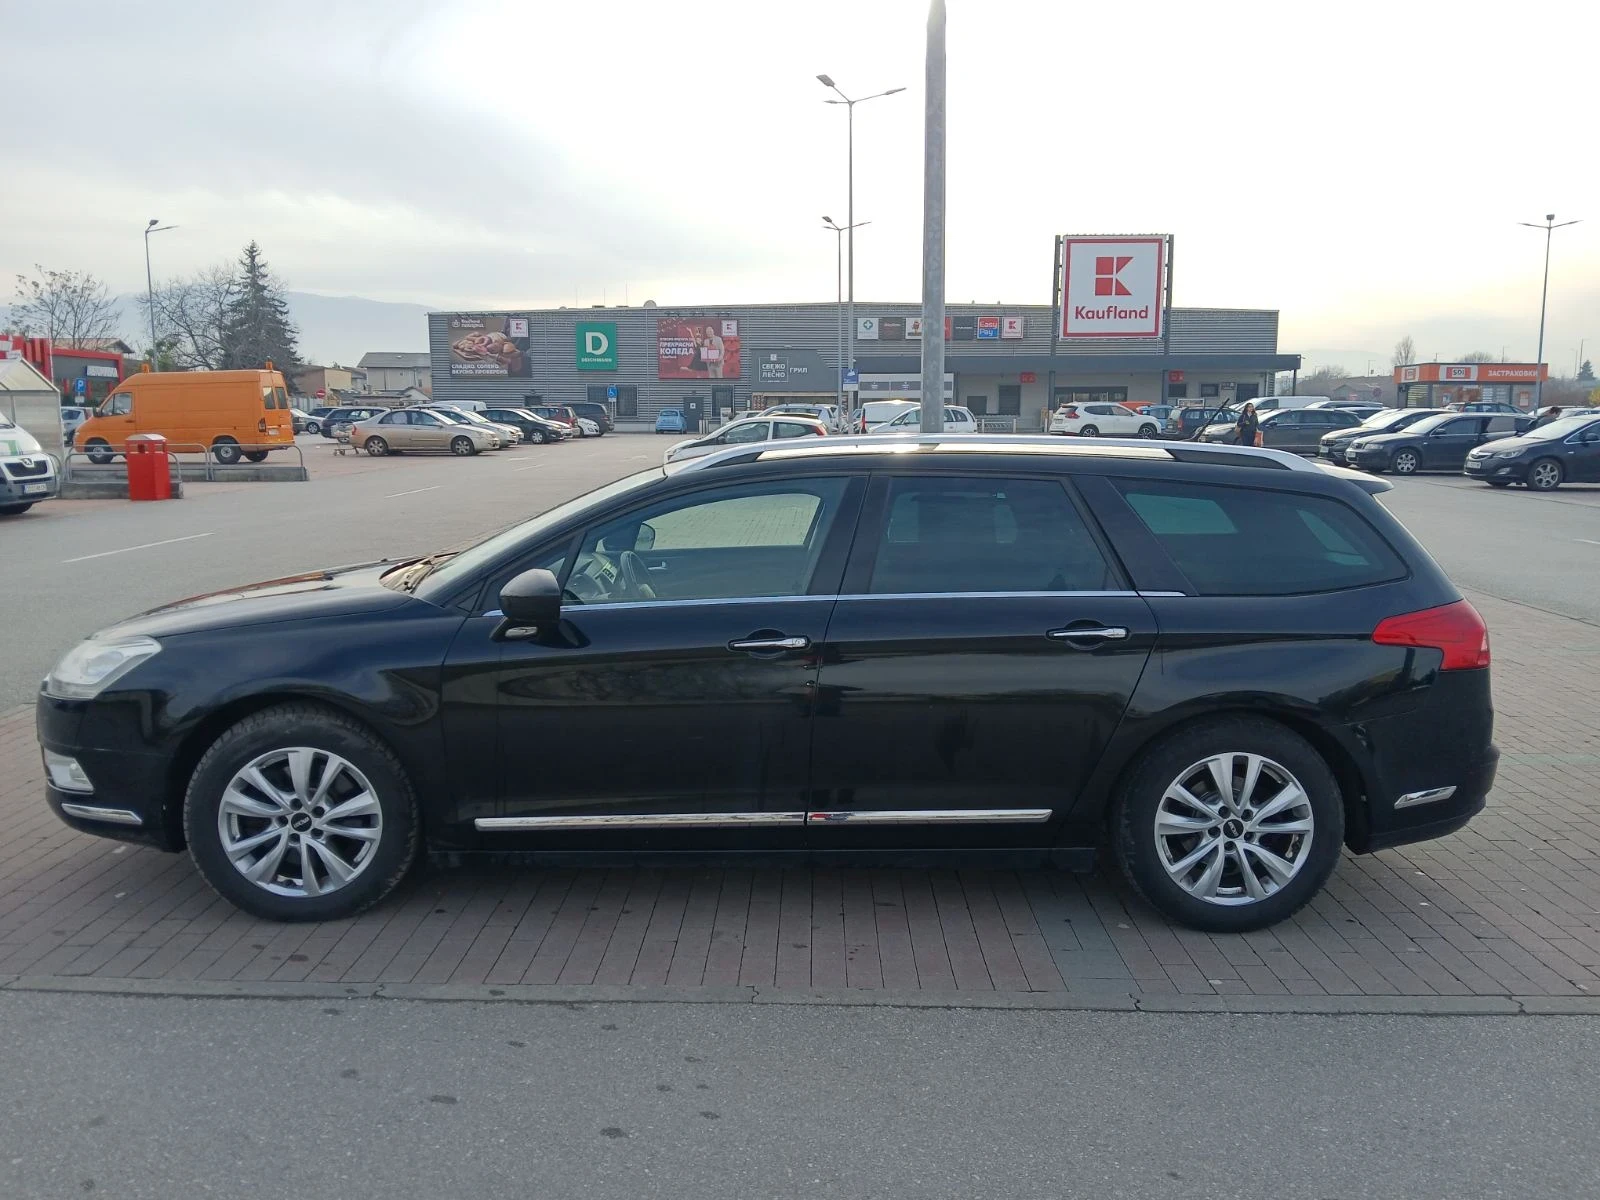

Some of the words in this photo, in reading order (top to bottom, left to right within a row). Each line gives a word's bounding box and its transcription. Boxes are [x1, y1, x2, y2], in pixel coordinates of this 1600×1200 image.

[1075, 305, 1148, 320] Kaufland
[980, 328, 993, 336] Pay
[585, 331, 609, 355] D
